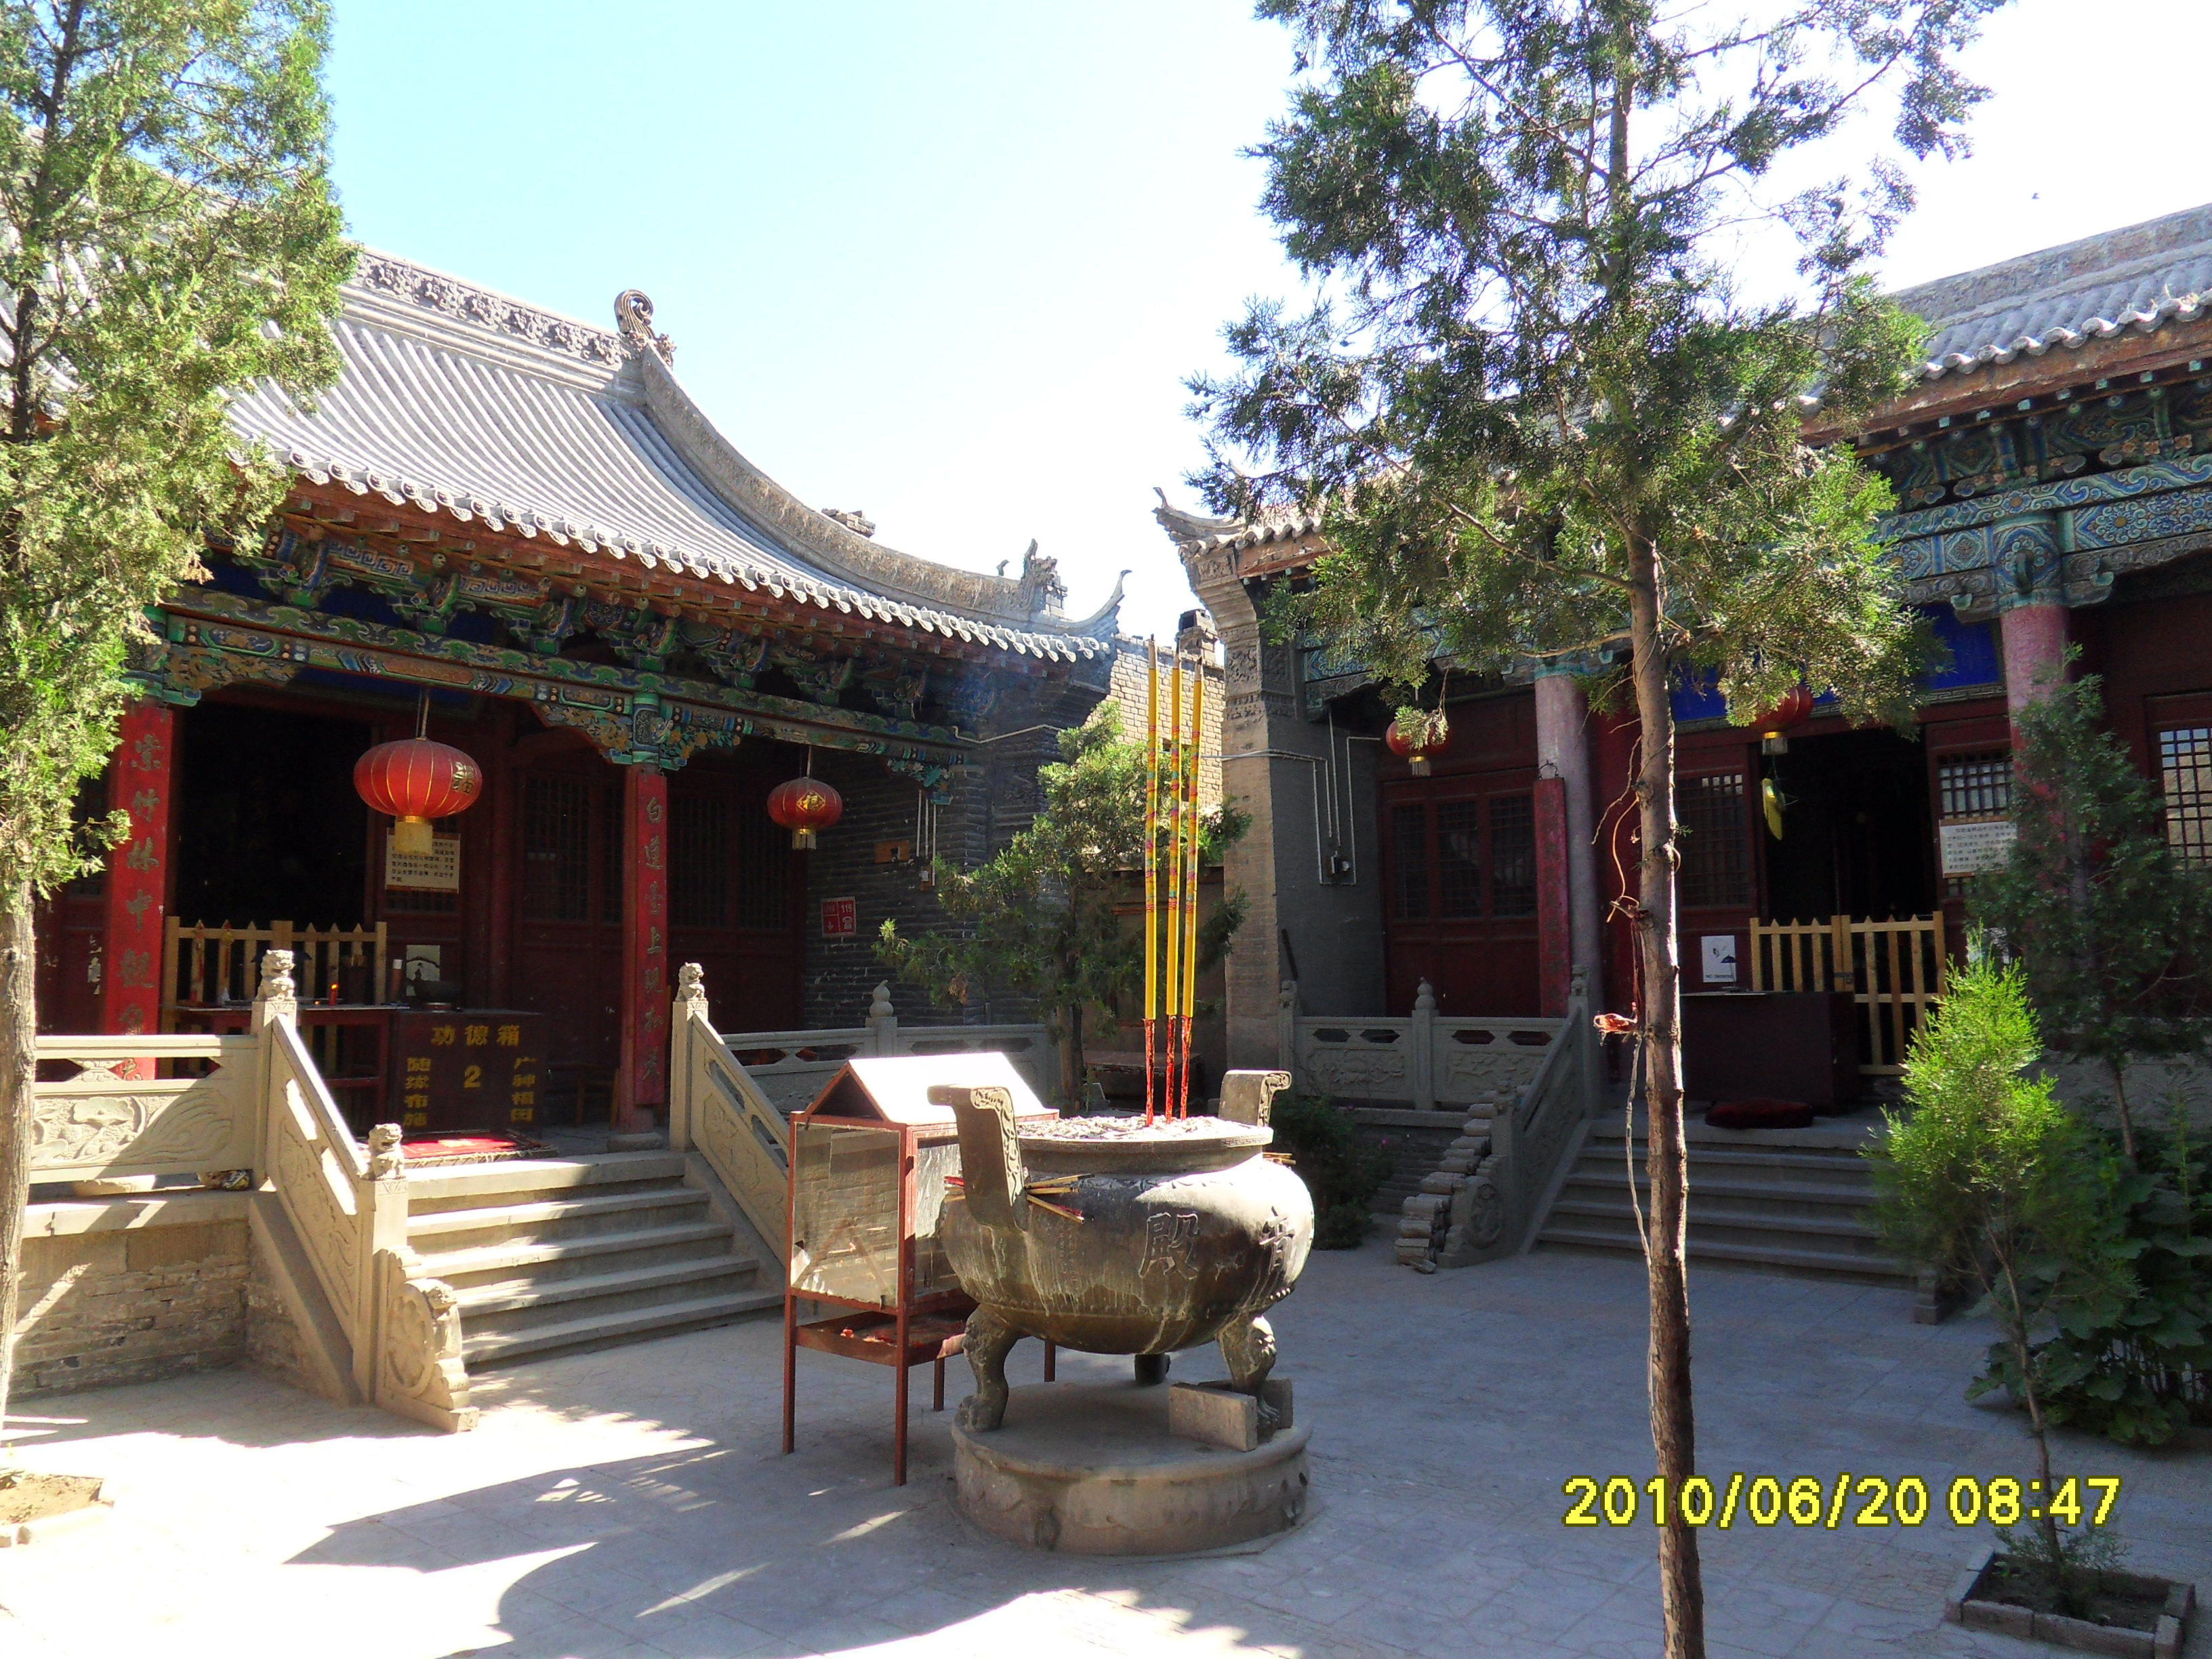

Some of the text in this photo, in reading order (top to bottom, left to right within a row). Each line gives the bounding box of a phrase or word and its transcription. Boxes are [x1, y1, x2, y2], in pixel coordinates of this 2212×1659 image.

[841, 903, 853, 913] 119
[430, 1025, 520, 1046] 功德箱
[464, 1065, 482, 1088] 2
